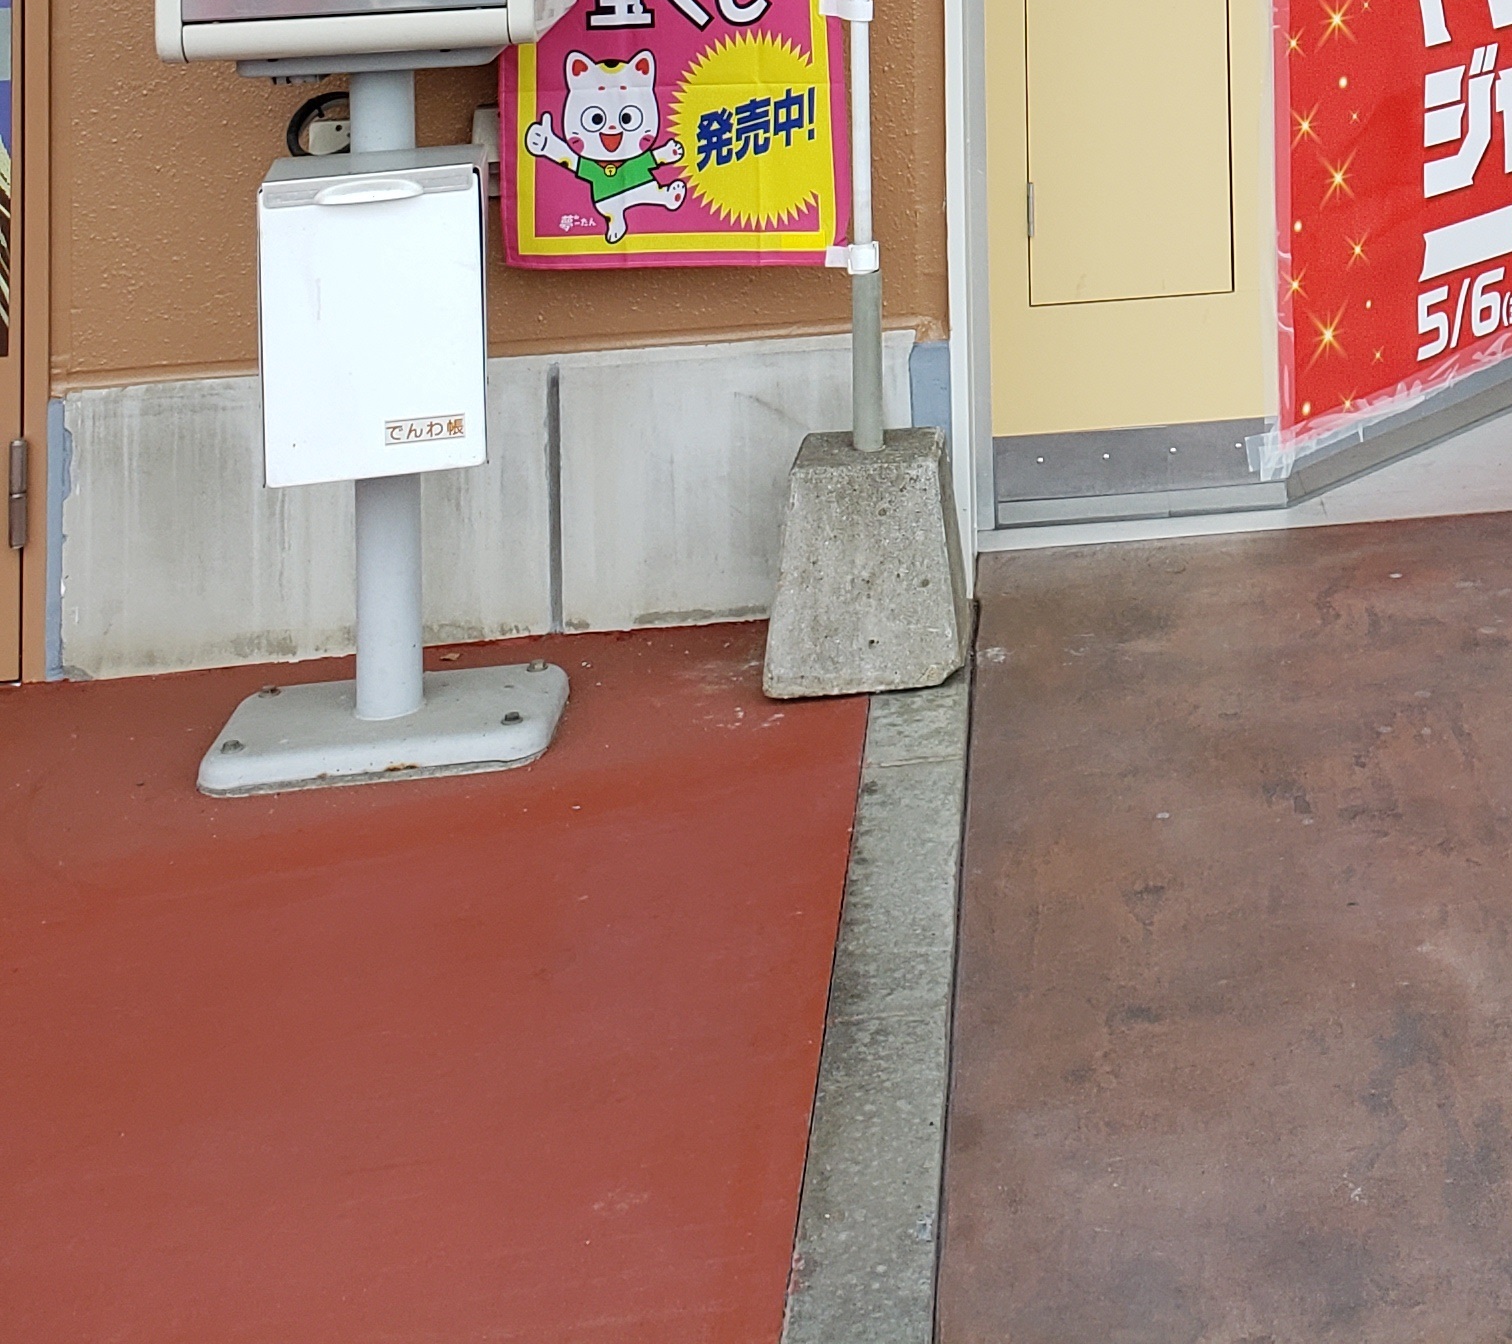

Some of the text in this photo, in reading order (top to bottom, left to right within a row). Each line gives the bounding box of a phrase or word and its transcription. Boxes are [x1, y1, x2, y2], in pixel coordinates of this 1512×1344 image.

[695, 86, 816, 173] 発売中!
[385, 417, 465, 442] でんわ帳
